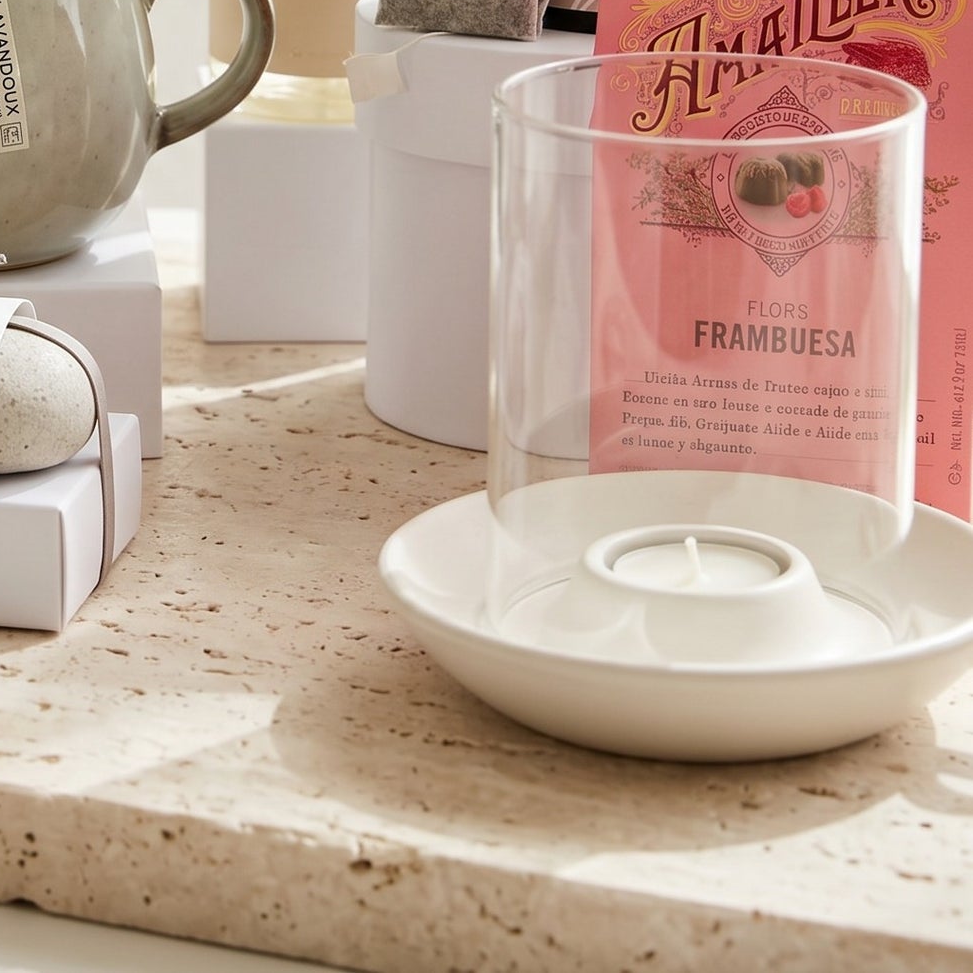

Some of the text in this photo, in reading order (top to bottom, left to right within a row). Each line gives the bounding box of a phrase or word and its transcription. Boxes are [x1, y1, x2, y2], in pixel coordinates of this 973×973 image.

[747, 300, 809, 320] FLORS
[694, 320, 856, 358] FRAMBUESA
[742, 379, 759, 391] de
[673, 397, 689, 407] en
[833, 406, 849, 418] de
[622, 436, 634, 446] es
[677, 440, 686, 452] y
